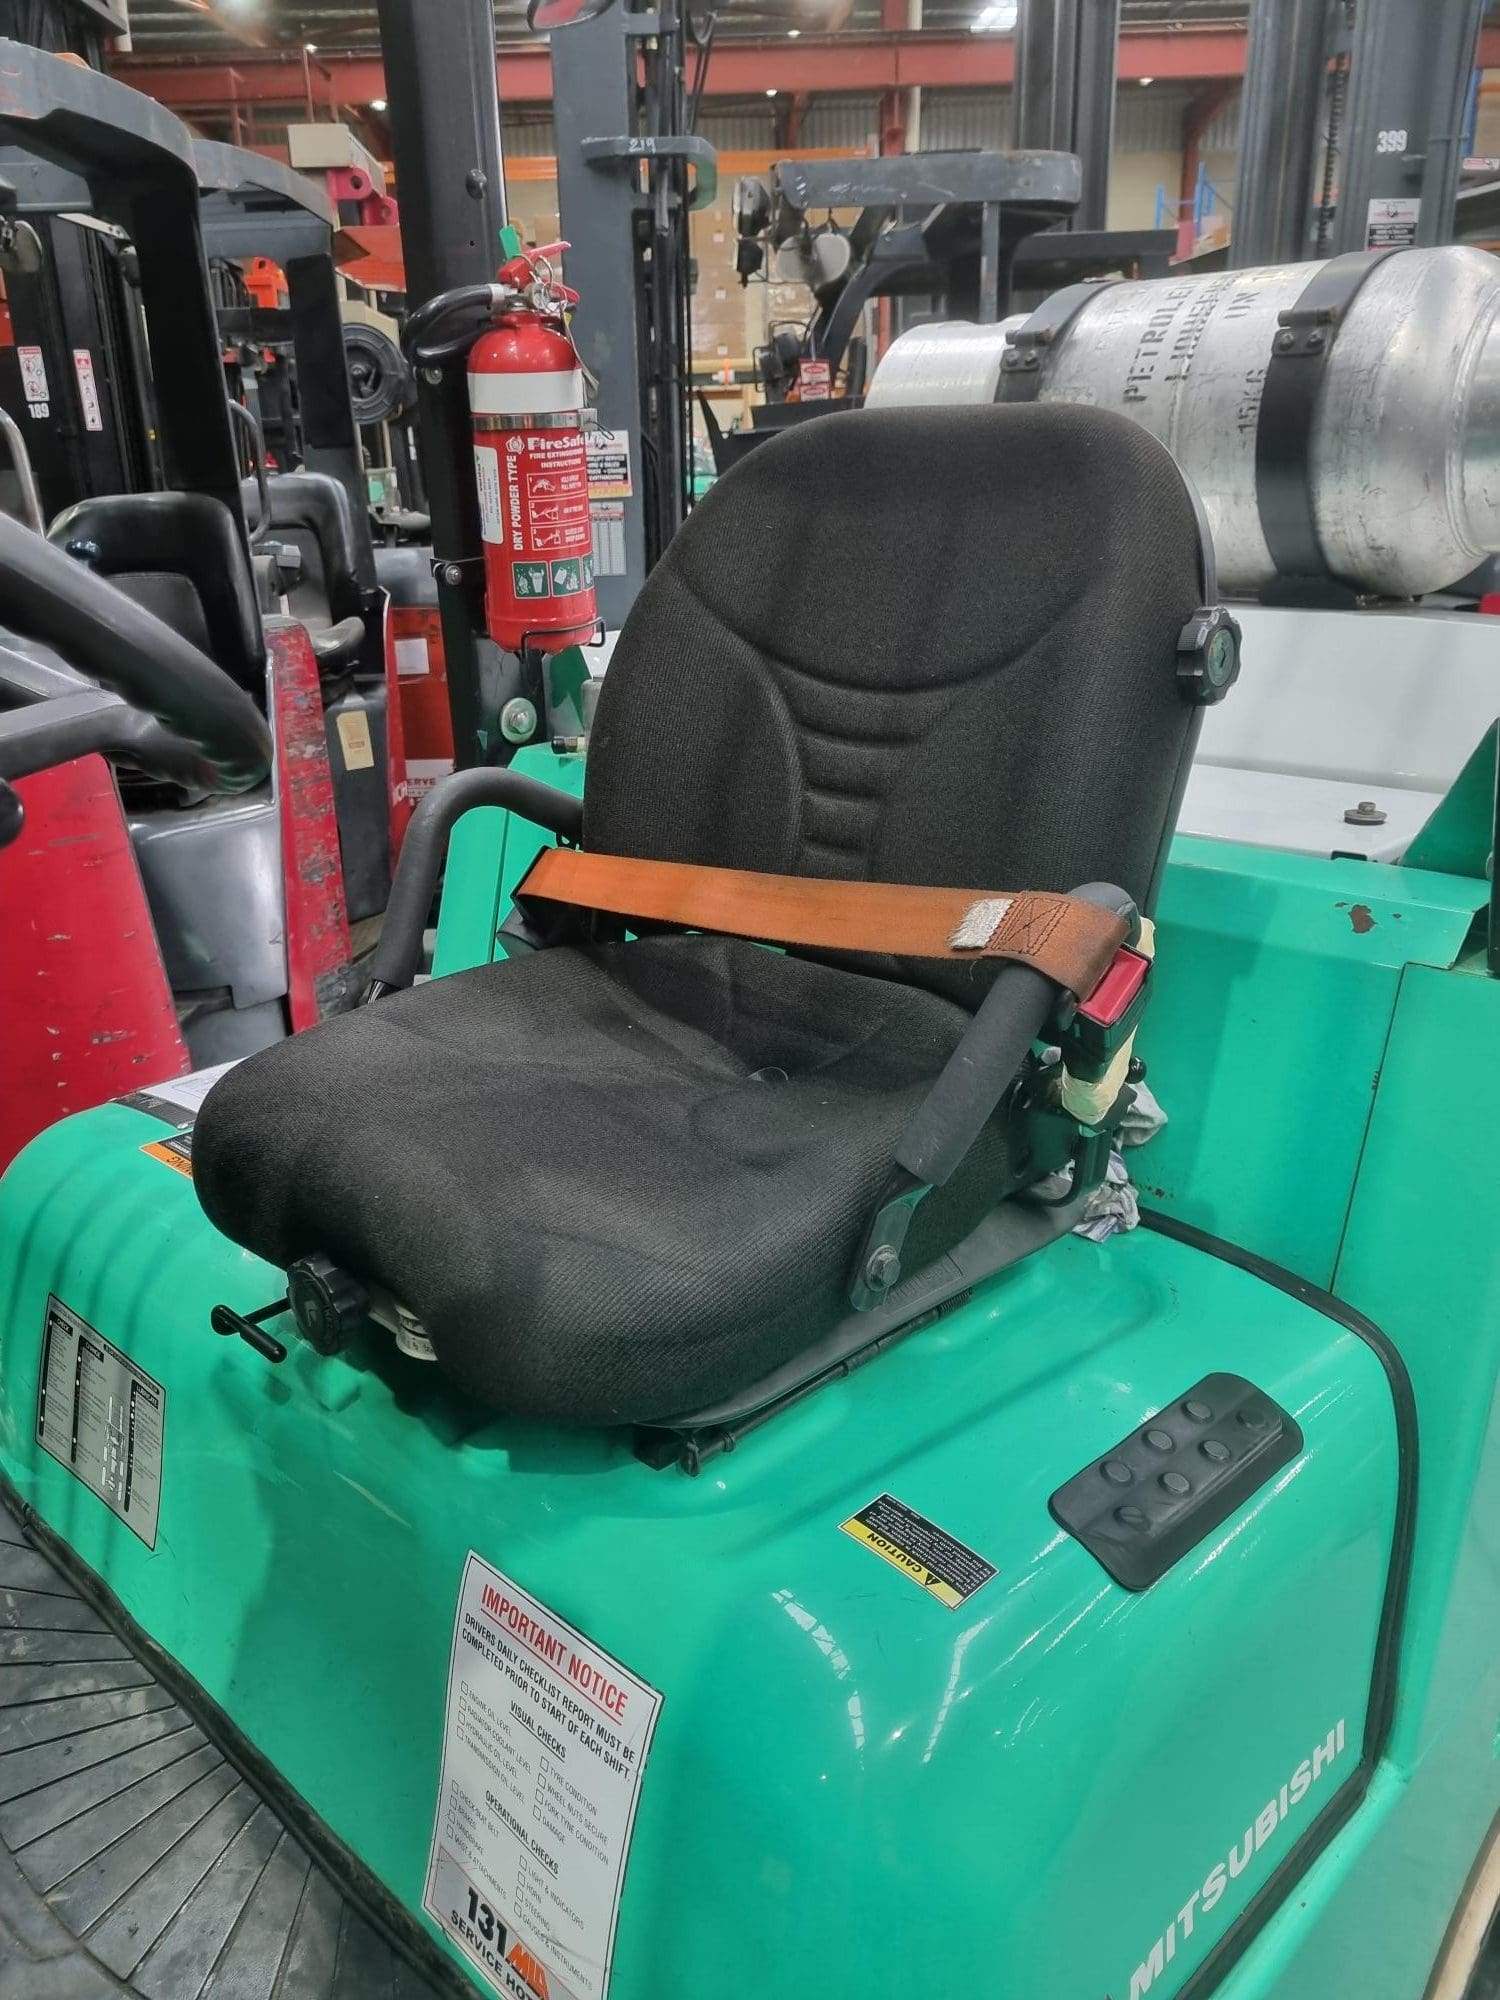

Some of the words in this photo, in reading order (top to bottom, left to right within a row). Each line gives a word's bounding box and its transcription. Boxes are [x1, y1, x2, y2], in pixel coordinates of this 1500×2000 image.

[1377, 130, 1407, 152] 399
[28, 403, 49, 418] 189
[507, 455, 518, 484] TYPE
[509, 486, 522, 528] POWDER
[512, 531, 523, 550] DRY
[866, 1532, 923, 1574] CAUTION
[482, 1584, 567, 1666] IMPORTANT
[568, 1653, 628, 1718] NOTICE
[462, 1628, 503, 1671] COMPLETED
[505, 1662, 529, 1694] PRIOR
[530, 1685, 540, 1704] TO
[541, 1691, 566, 1724] START
[567, 1720, 579, 1738] OF
[580, 1731, 602, 1757] EACH
[603, 1750, 631, 1782] SHIFT.
[465, 1613, 496, 1647] DRIVERS
[498, 1639, 518, 1665] DAILY
[519, 1659, 562, 1702] CHECKLIST
[562, 1692, 594, 1730] REPORT
[596, 1724, 622, 1752] MUST
[623, 1745, 635, 1763] BE
[469, 1690, 487, 1713] ENGINE
[497, 1719, 511, 1737] LEVEL
[511, 1700, 535, 1731] VISUAL
[537, 1726, 566, 1758] CHECKS
[502, 1758, 518, 1779] LEVEL
[516, 1752, 531, 1774] LEVEL
[510, 1783, 524, 1803] LEVEL
[547, 1783, 566, 1808] WHEEL
[567, 1802, 583, 1823] NUTS
[584, 1818, 608, 1845] SECURE
[550, 1766, 564, 1786] TYRE
[565, 1781, 597, 1816] CONDITION
[485, 1789, 530, 1845] OPERATIONAL
[530, 1839, 559, 1875] CHECKS
[545, 1799, 559, 1819] FORK
[561, 1815, 575, 1834] TYNE
[575, 1830, 609, 1865] CONDITION
[1130, 1718, 1345, 2000] MITSUBISHI
[468, 1886, 507, 1958] 131
[550, 1890, 584, 1930] INDICATORS
[451, 1909, 503, 1977] SERVICE
